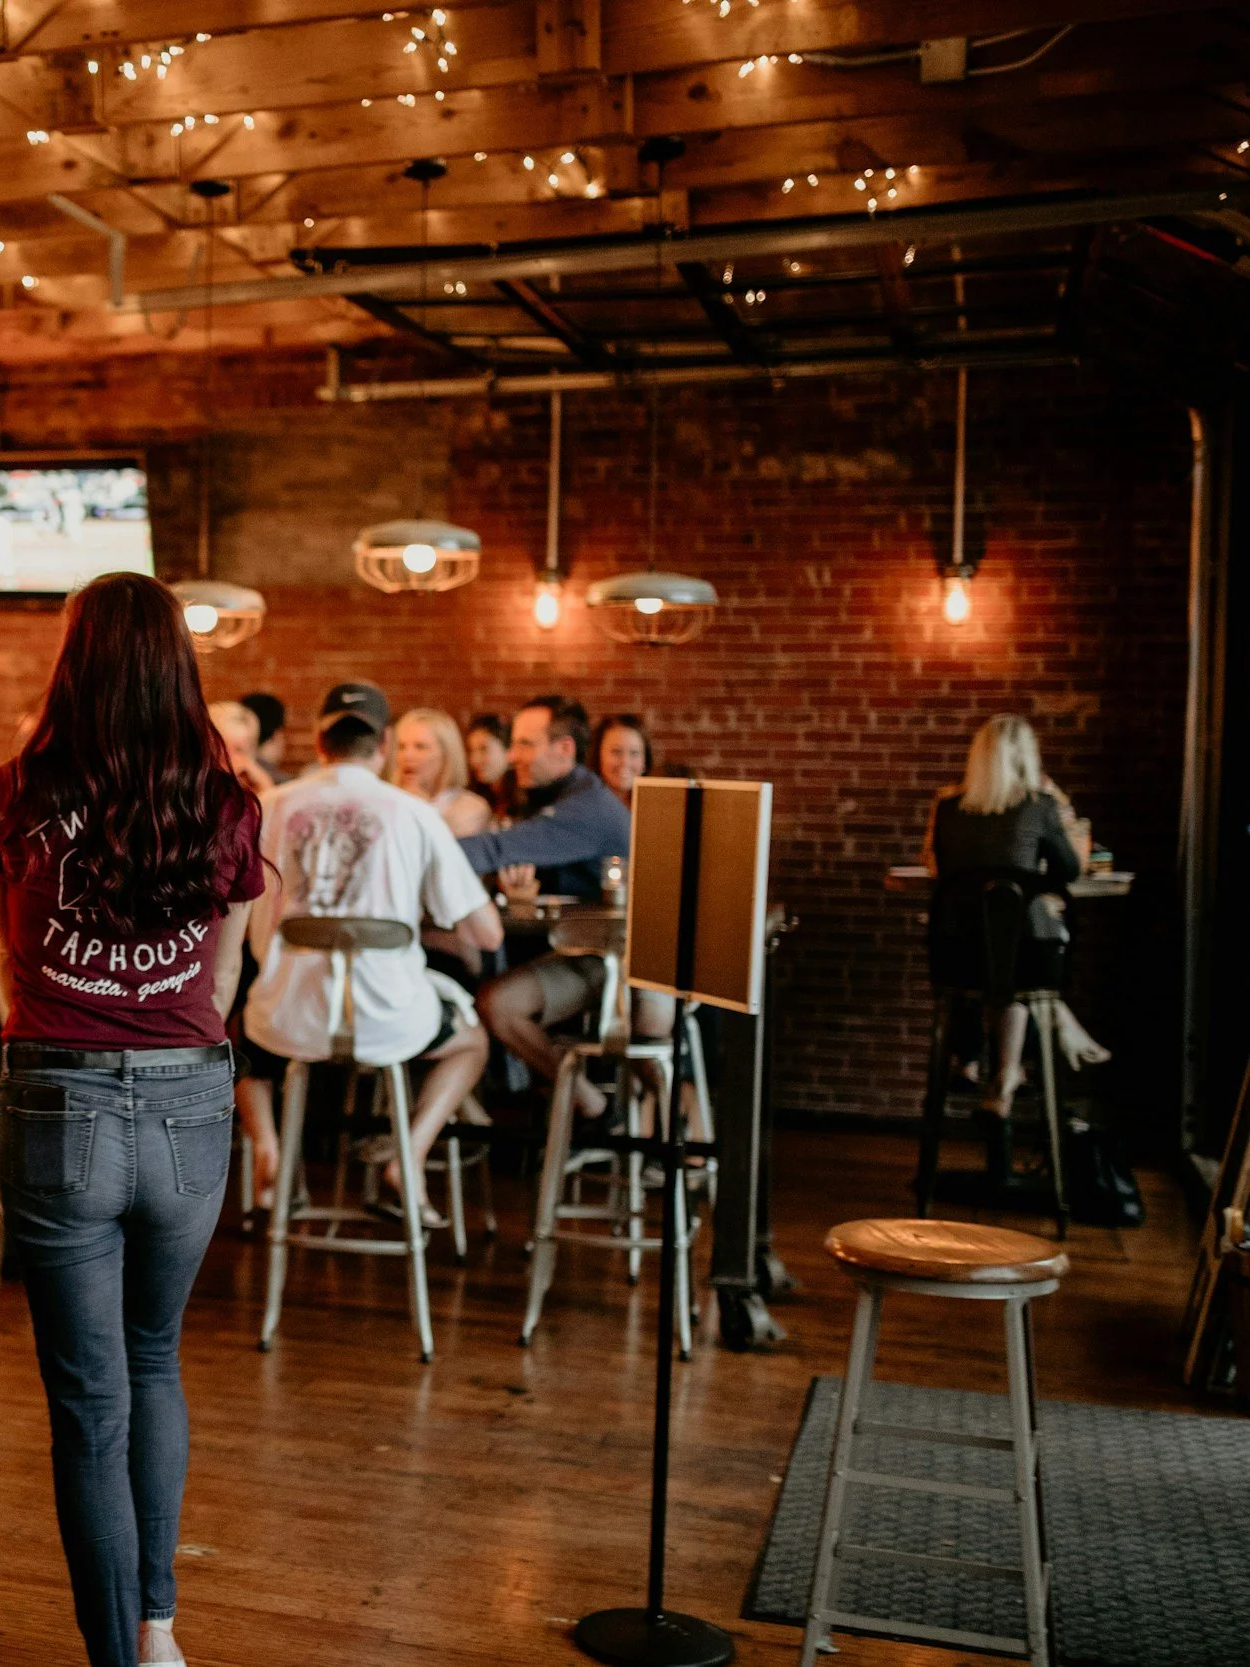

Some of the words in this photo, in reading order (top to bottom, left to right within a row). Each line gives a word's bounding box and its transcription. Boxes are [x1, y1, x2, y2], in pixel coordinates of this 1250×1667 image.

[26, 805, 89, 854] TW
[43, 917, 209, 972] TAPHOUSE
[137, 961, 202, 1003] georgia
